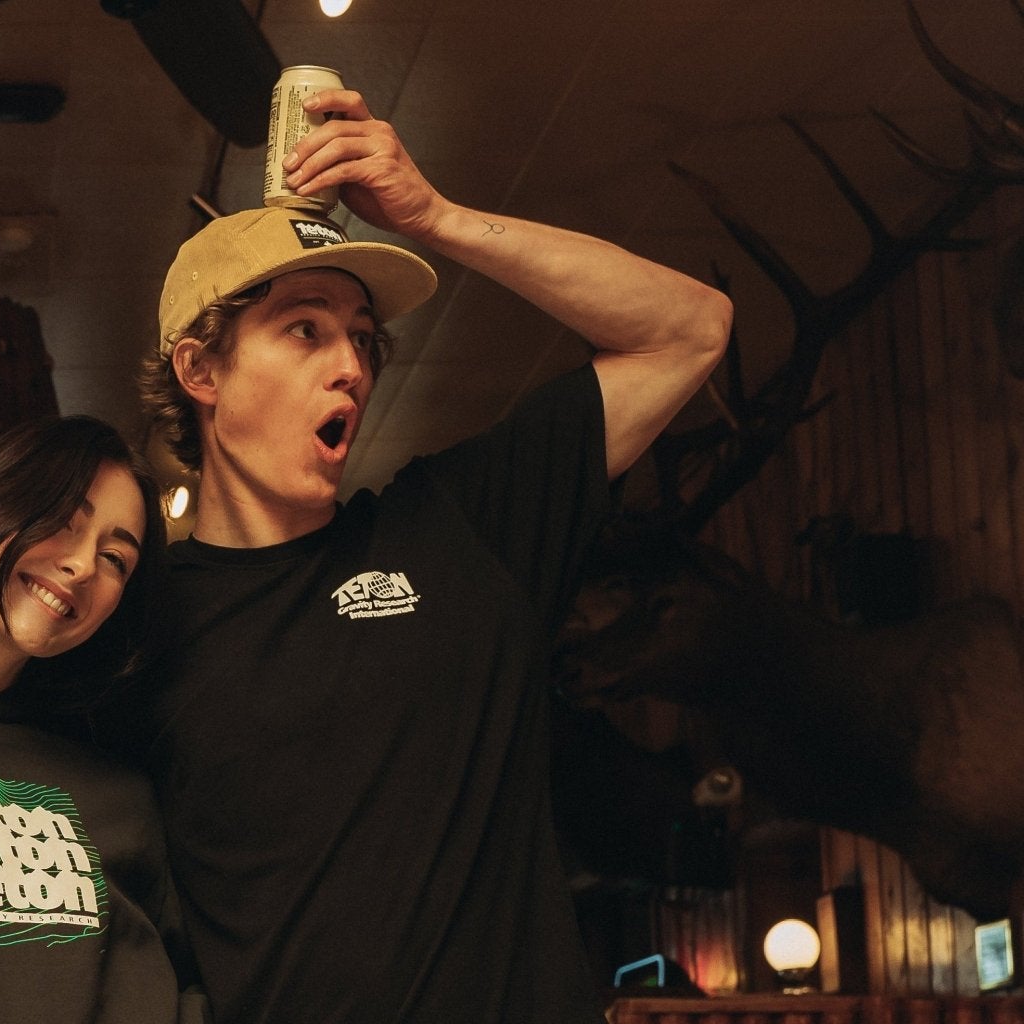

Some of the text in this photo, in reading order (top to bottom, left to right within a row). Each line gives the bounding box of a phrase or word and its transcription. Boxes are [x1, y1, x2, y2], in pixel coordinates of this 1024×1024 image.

[337, 596, 419, 615] Gravity Research
[349, 604, 415, 620] International
[18, 914, 93, 925] RESEARCH
